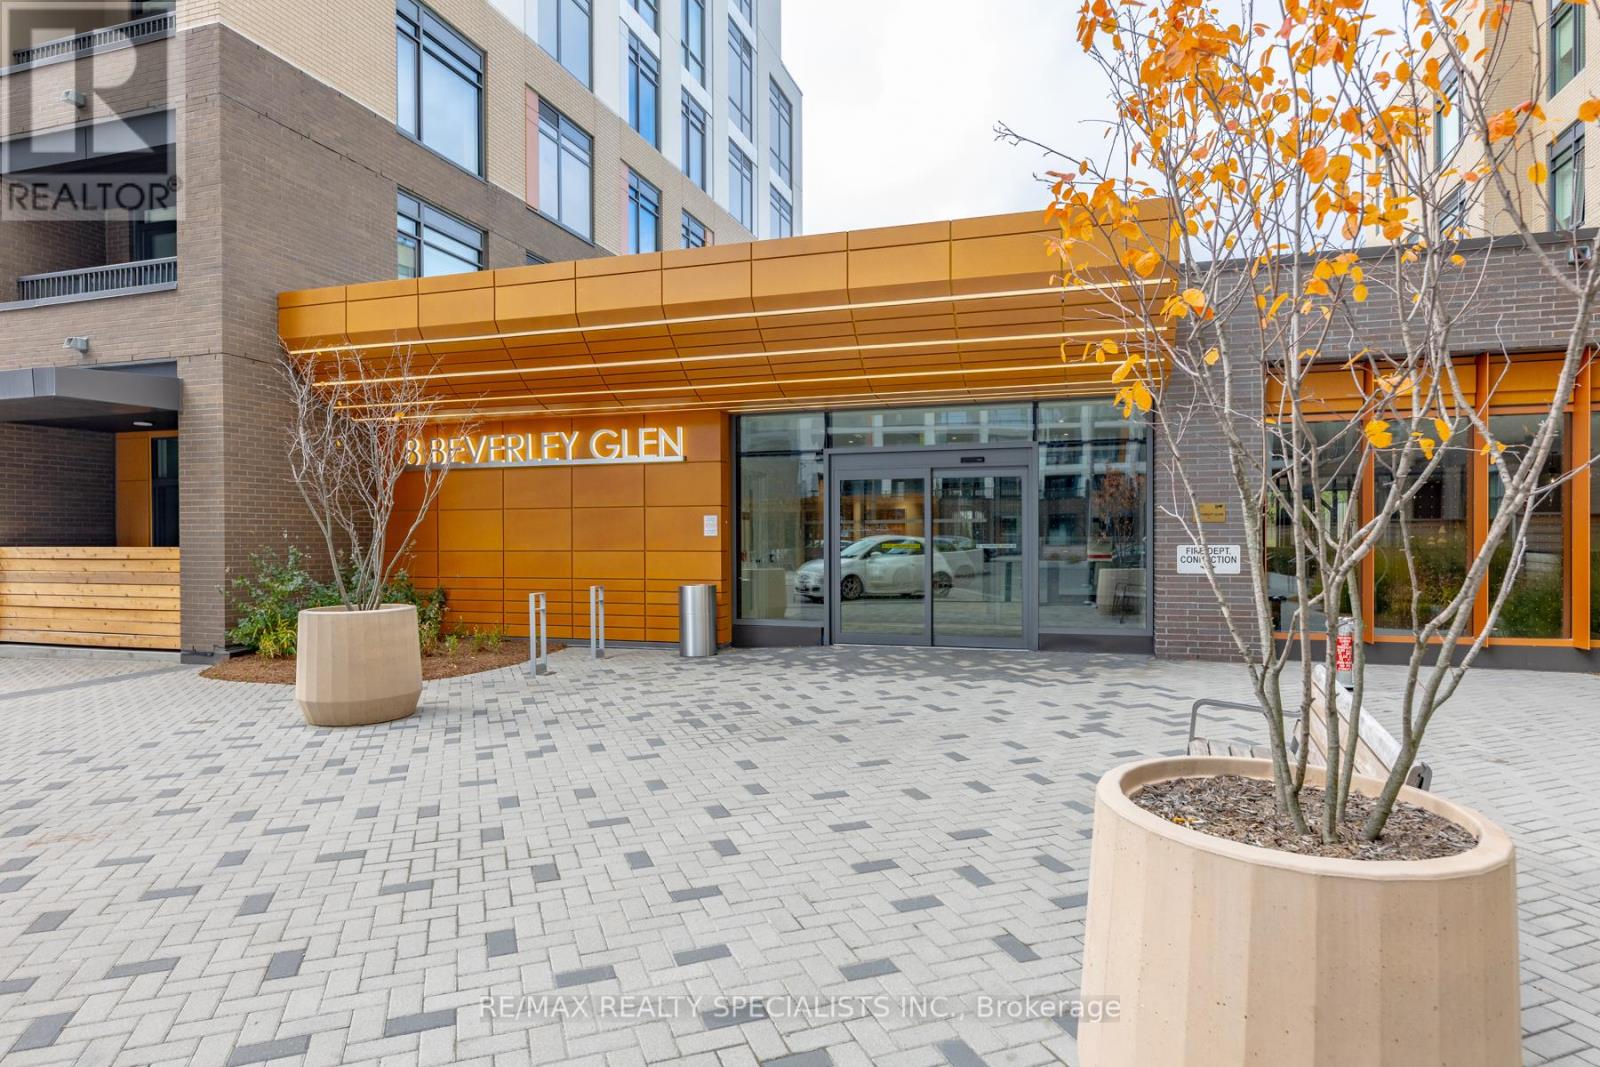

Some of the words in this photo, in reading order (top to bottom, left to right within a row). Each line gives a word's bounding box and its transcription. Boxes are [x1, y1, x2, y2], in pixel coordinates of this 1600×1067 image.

[405, 438, 422, 466] 8
[430, 431, 580, 465] BEVERLEY
[589, 426, 684, 460] GLEN
[1180, 556, 1237, 564] CONCTION
